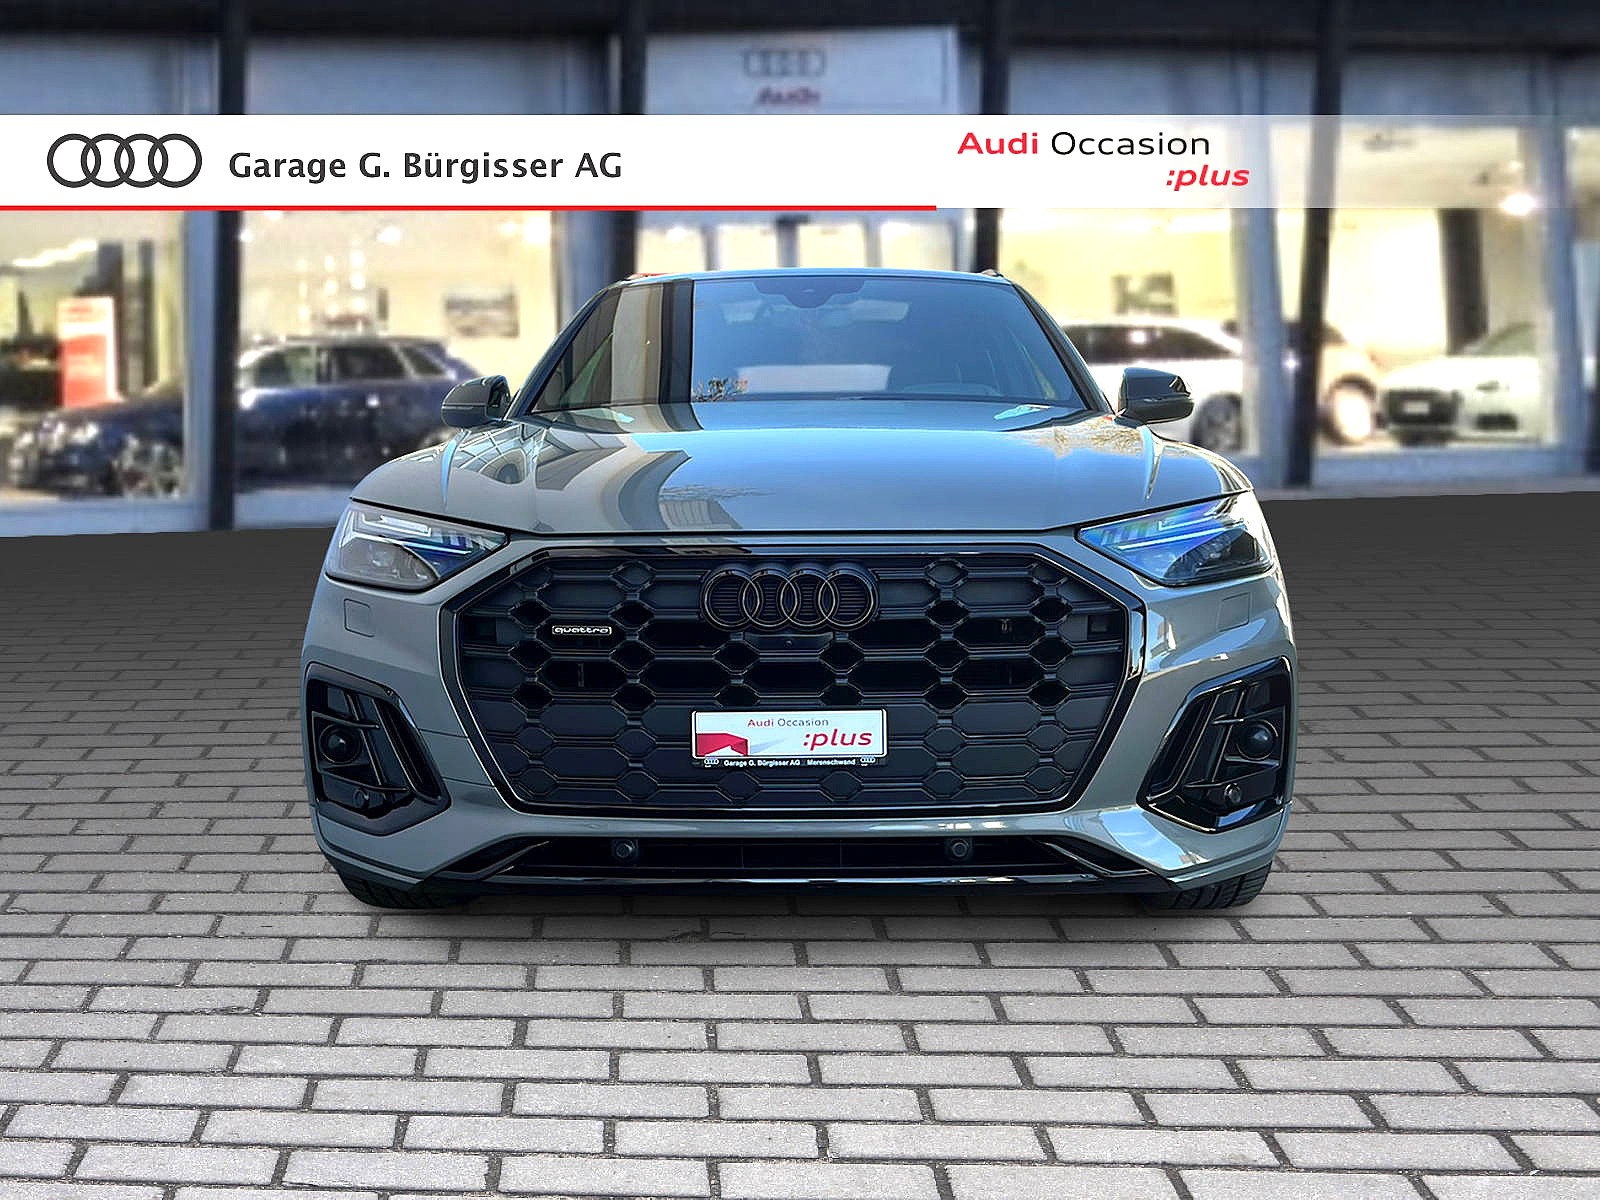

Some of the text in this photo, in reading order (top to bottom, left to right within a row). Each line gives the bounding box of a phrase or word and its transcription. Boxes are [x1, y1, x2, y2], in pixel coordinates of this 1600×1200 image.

[554, 626, 609, 635] quattro
[747, 717, 829, 728] Audi Occasion
[803, 728, 873, 751] :plus
[723, 759, 748, 768] Garage
[789, 759, 801, 767] AG
